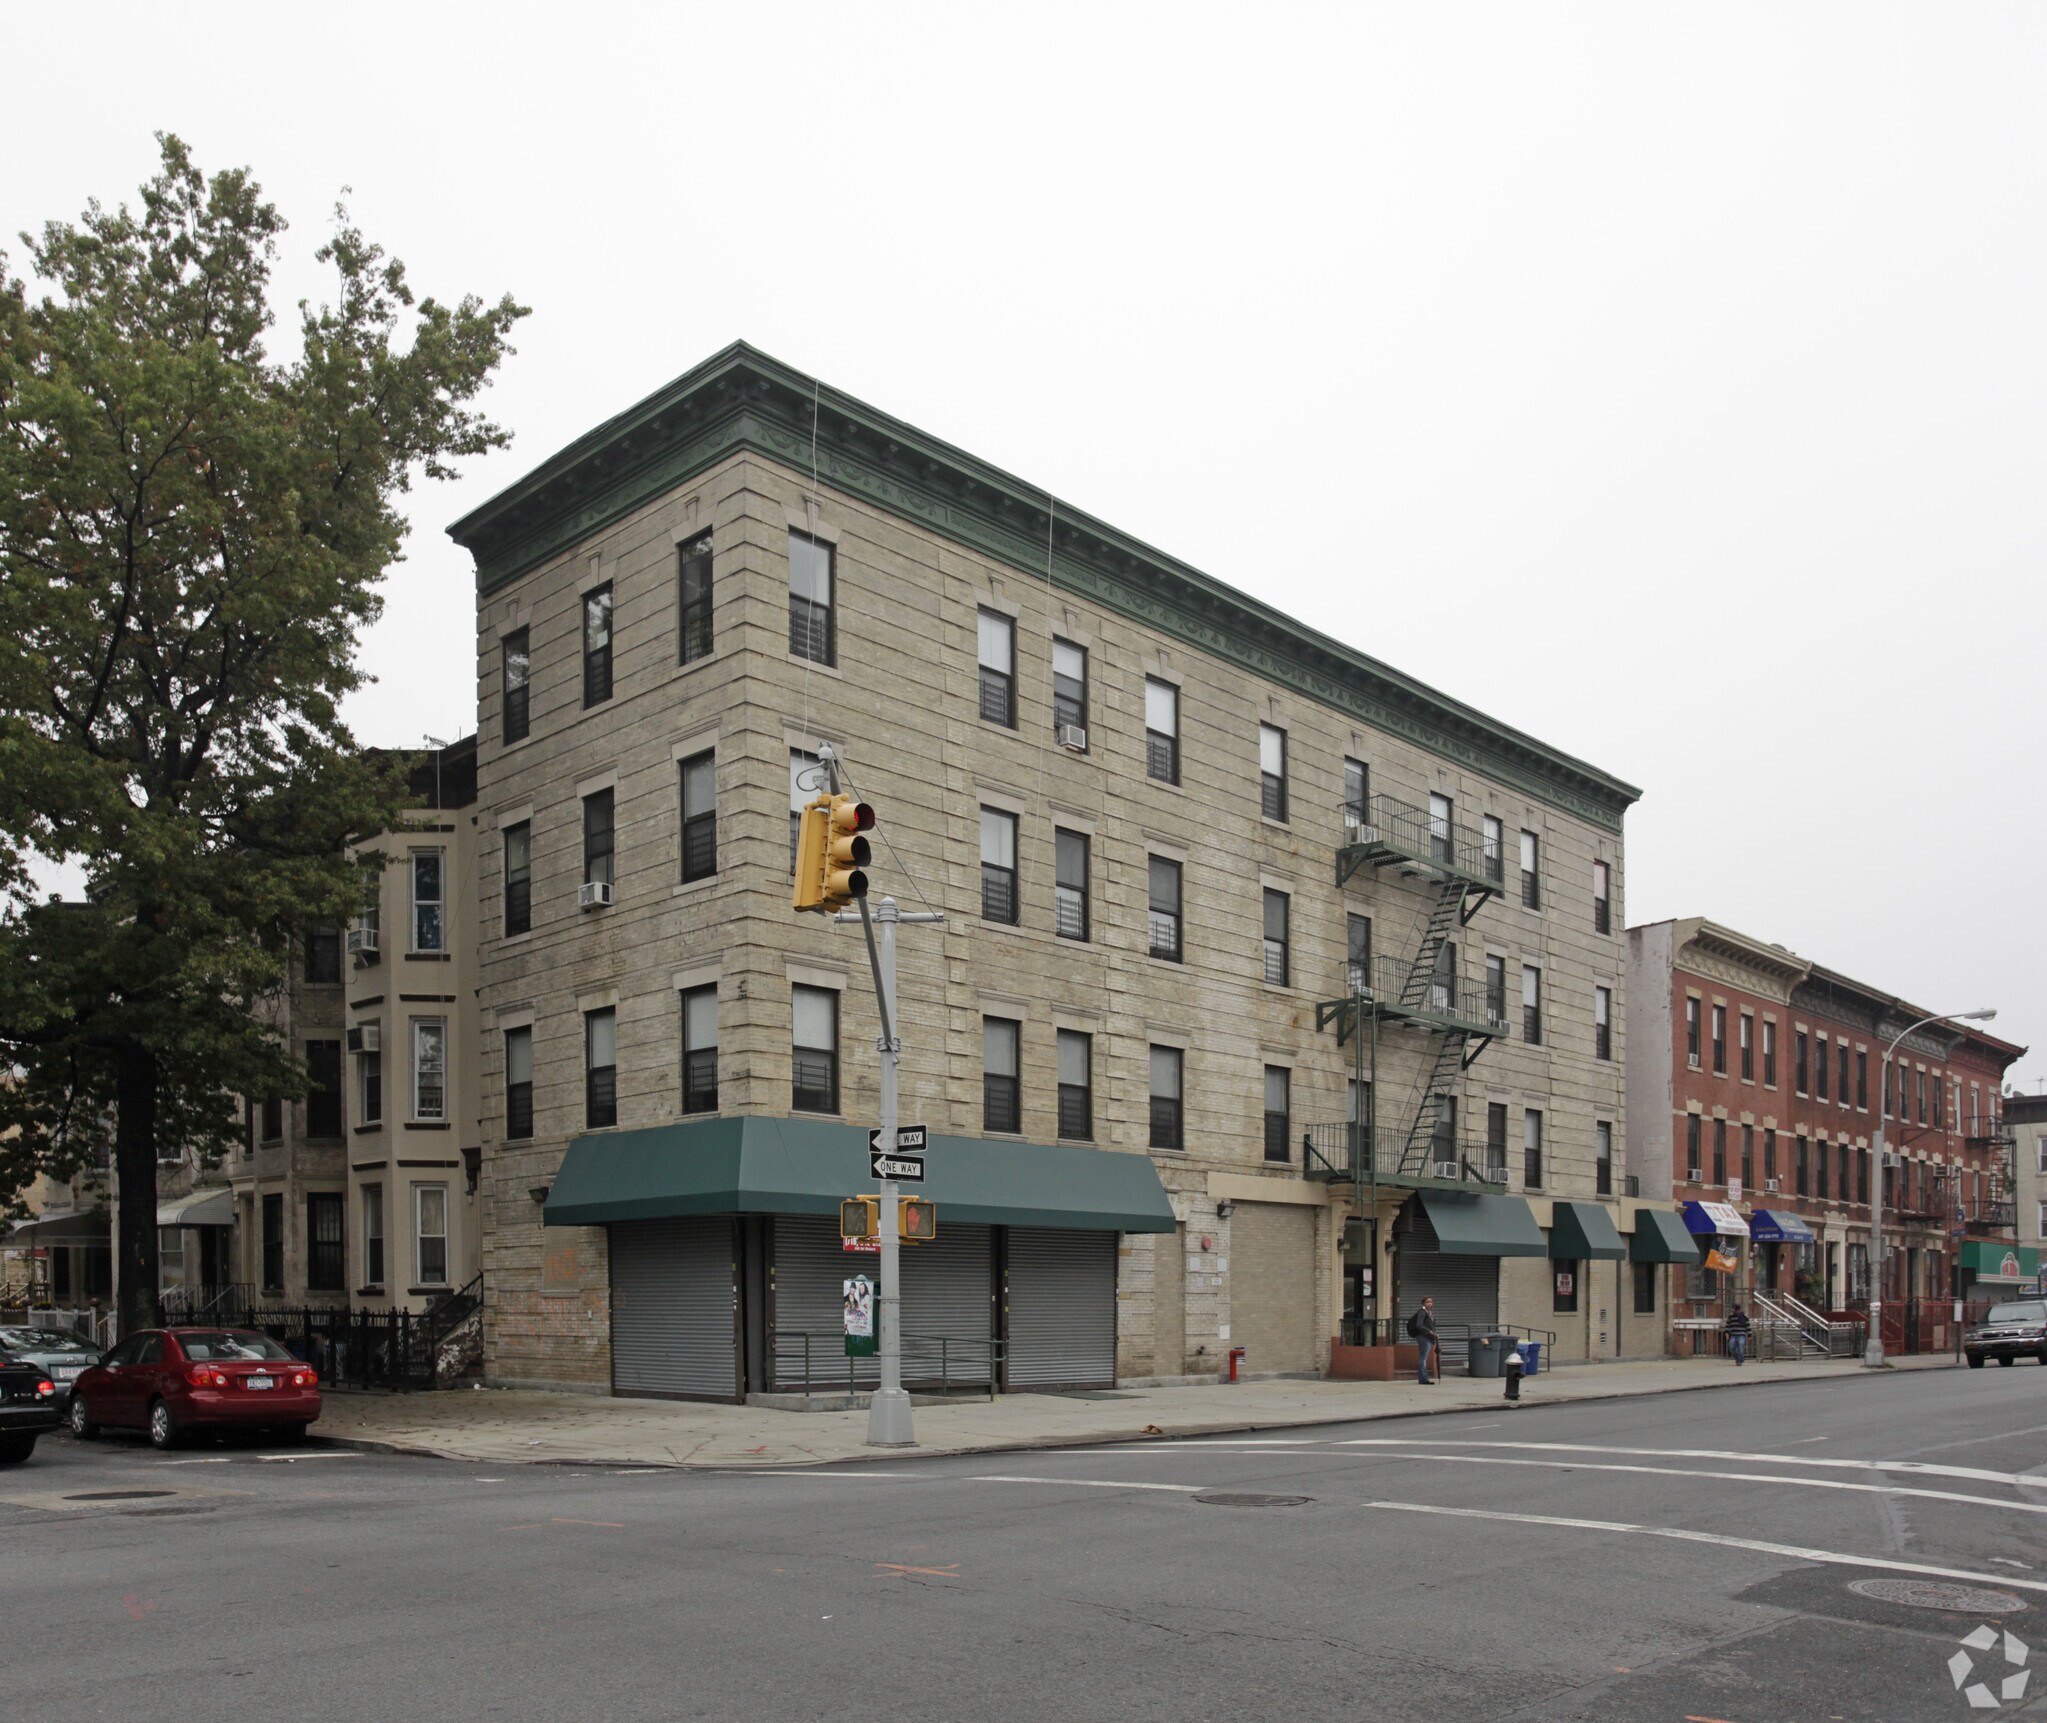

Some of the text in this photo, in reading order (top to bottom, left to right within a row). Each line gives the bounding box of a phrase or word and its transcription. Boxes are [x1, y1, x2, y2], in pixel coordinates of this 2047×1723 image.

[903, 1133, 921, 1144] WAY
[880, 1161, 917, 1175] ONE WAY
[1715, 1206, 1739, 1219] TAX
